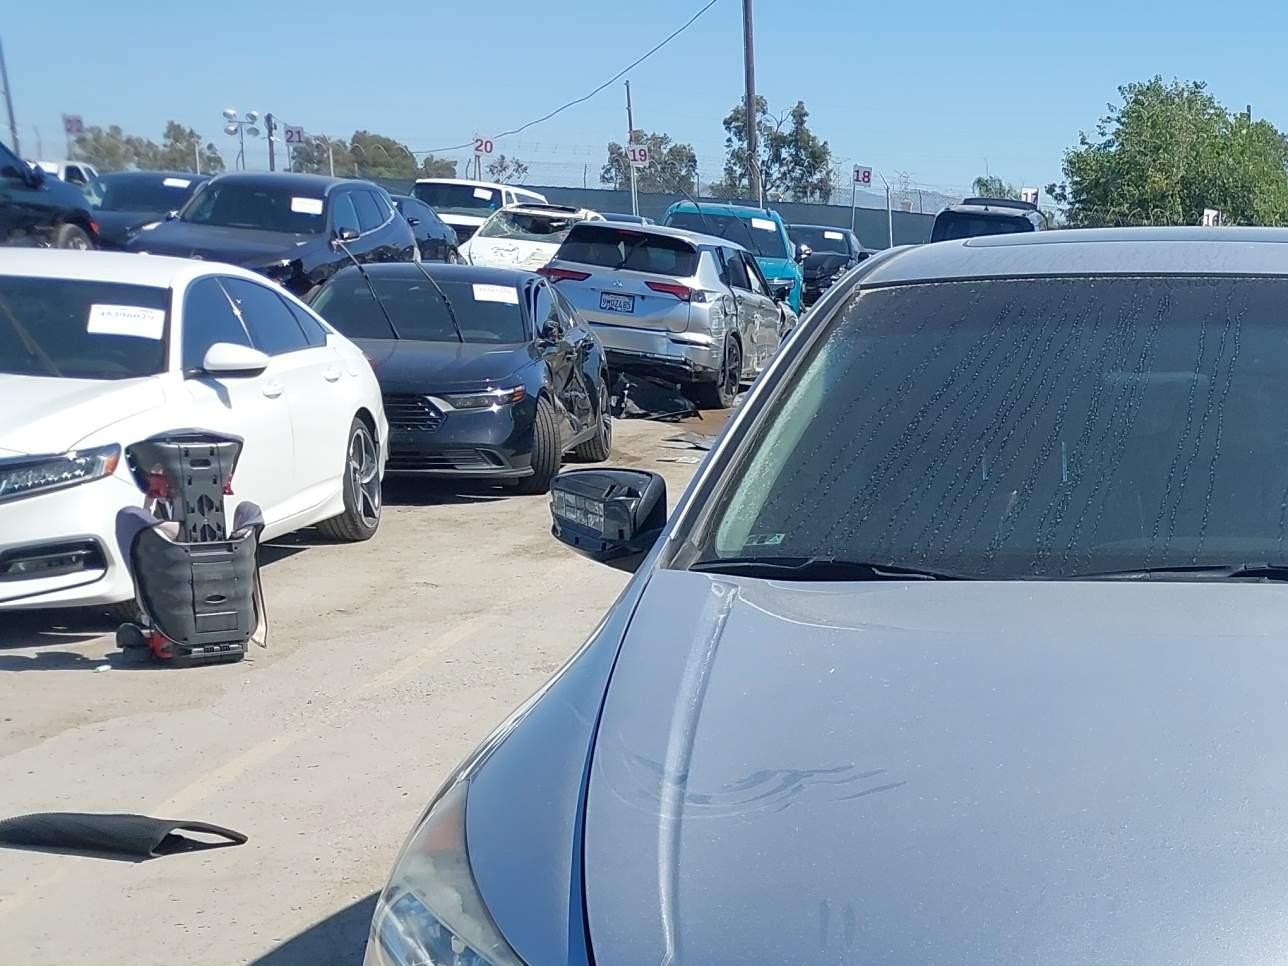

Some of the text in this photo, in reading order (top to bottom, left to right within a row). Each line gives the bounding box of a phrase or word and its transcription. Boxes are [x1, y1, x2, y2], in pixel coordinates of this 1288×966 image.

[286, 129, 303, 143] 21
[475, 138, 493, 154] 20
[630, 148, 647, 162] 19
[854, 170, 871, 183] 18
